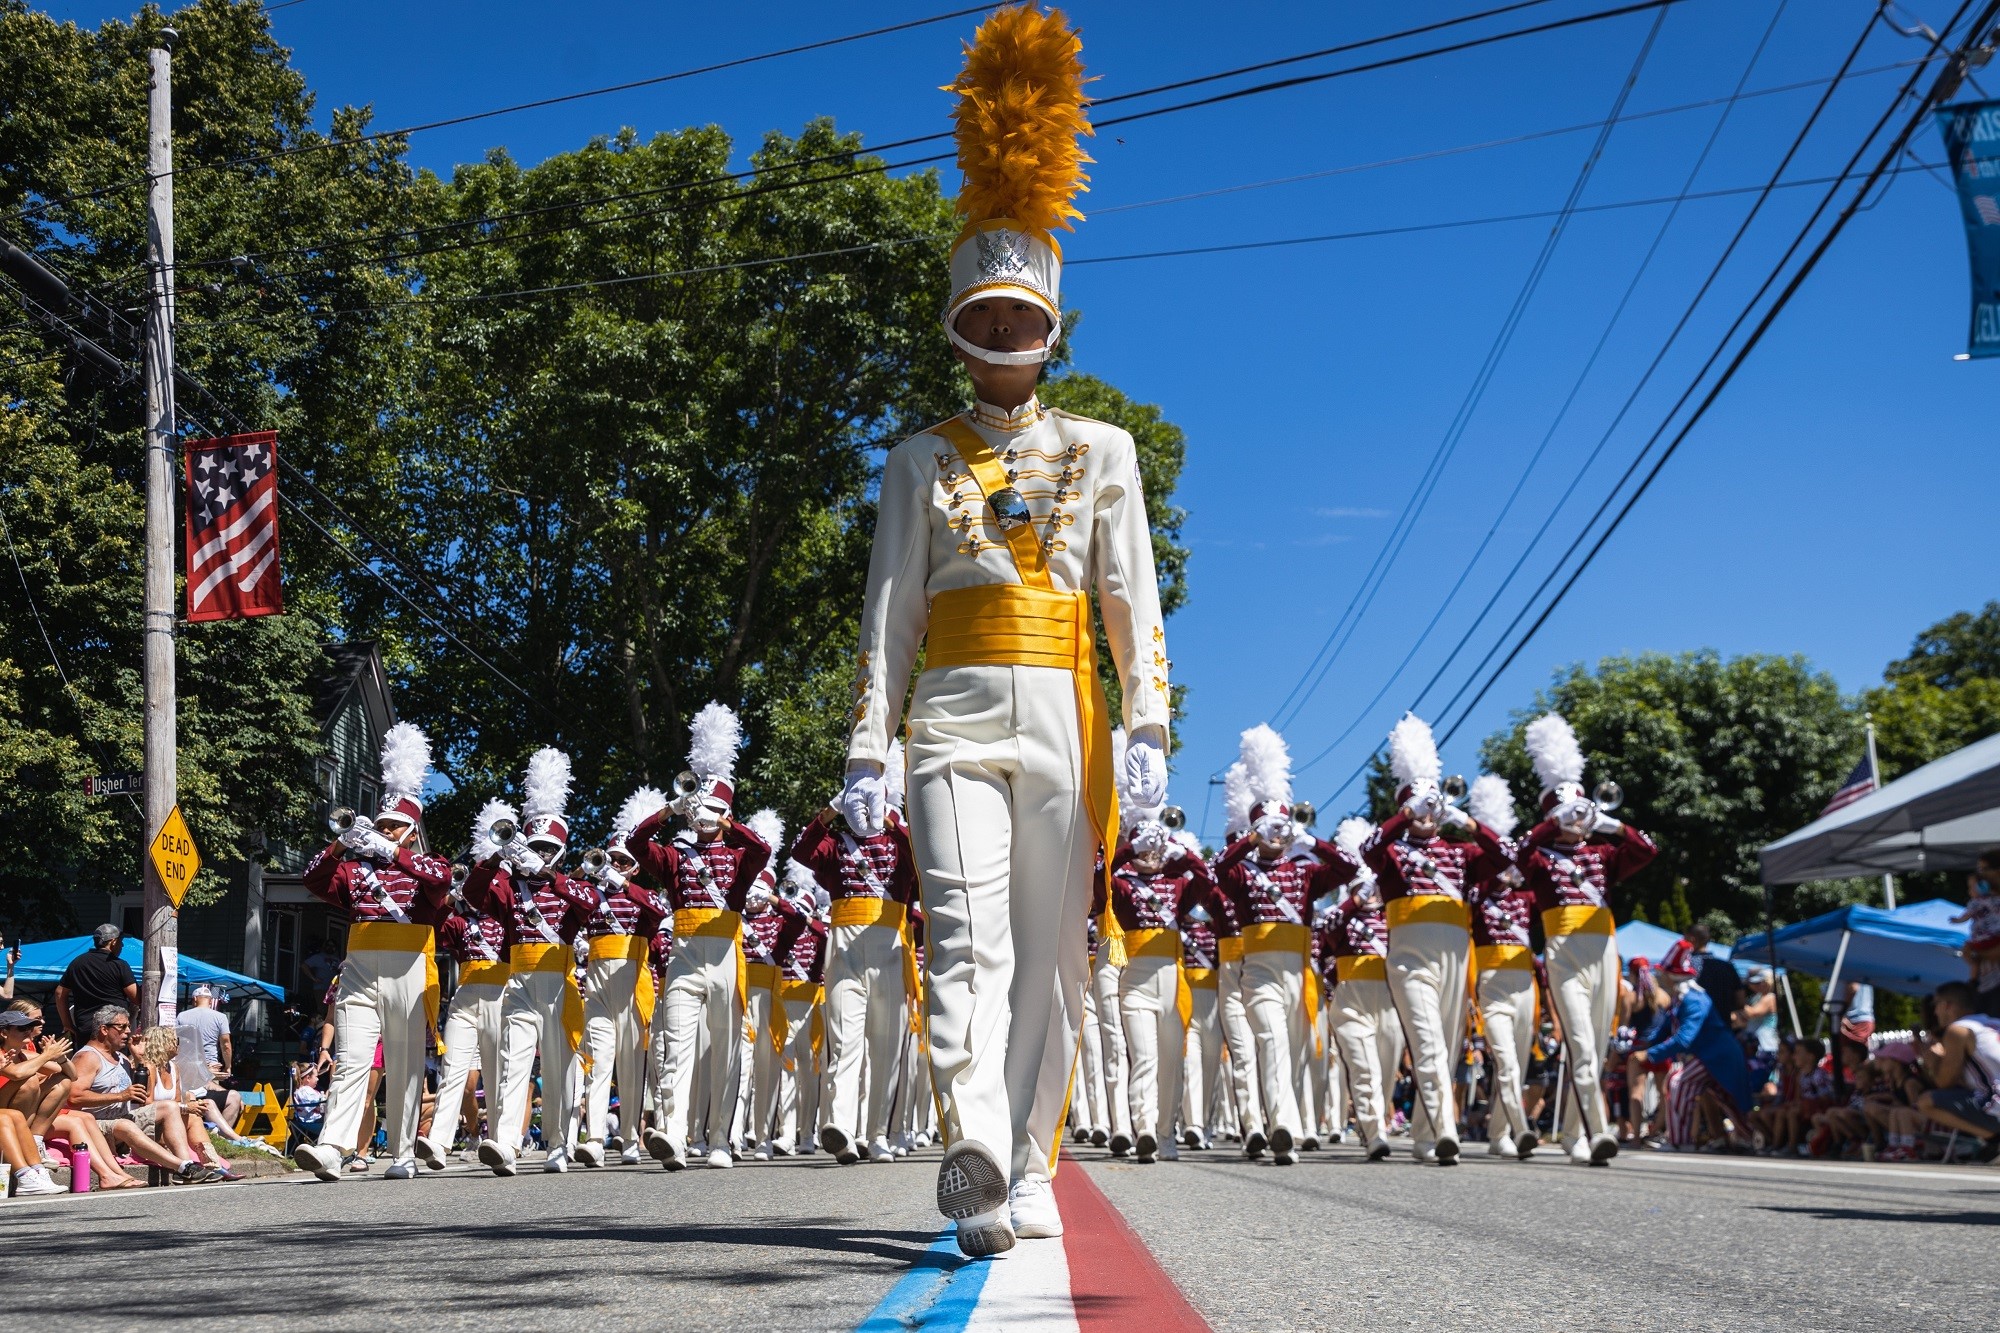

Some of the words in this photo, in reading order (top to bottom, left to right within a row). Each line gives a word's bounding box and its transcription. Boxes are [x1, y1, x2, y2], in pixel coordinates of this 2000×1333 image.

[95, 778, 124, 792] Usher
[128, 774, 143, 788] Ter
[162, 833, 190, 856] DEAD
[166, 860, 186, 881] END
